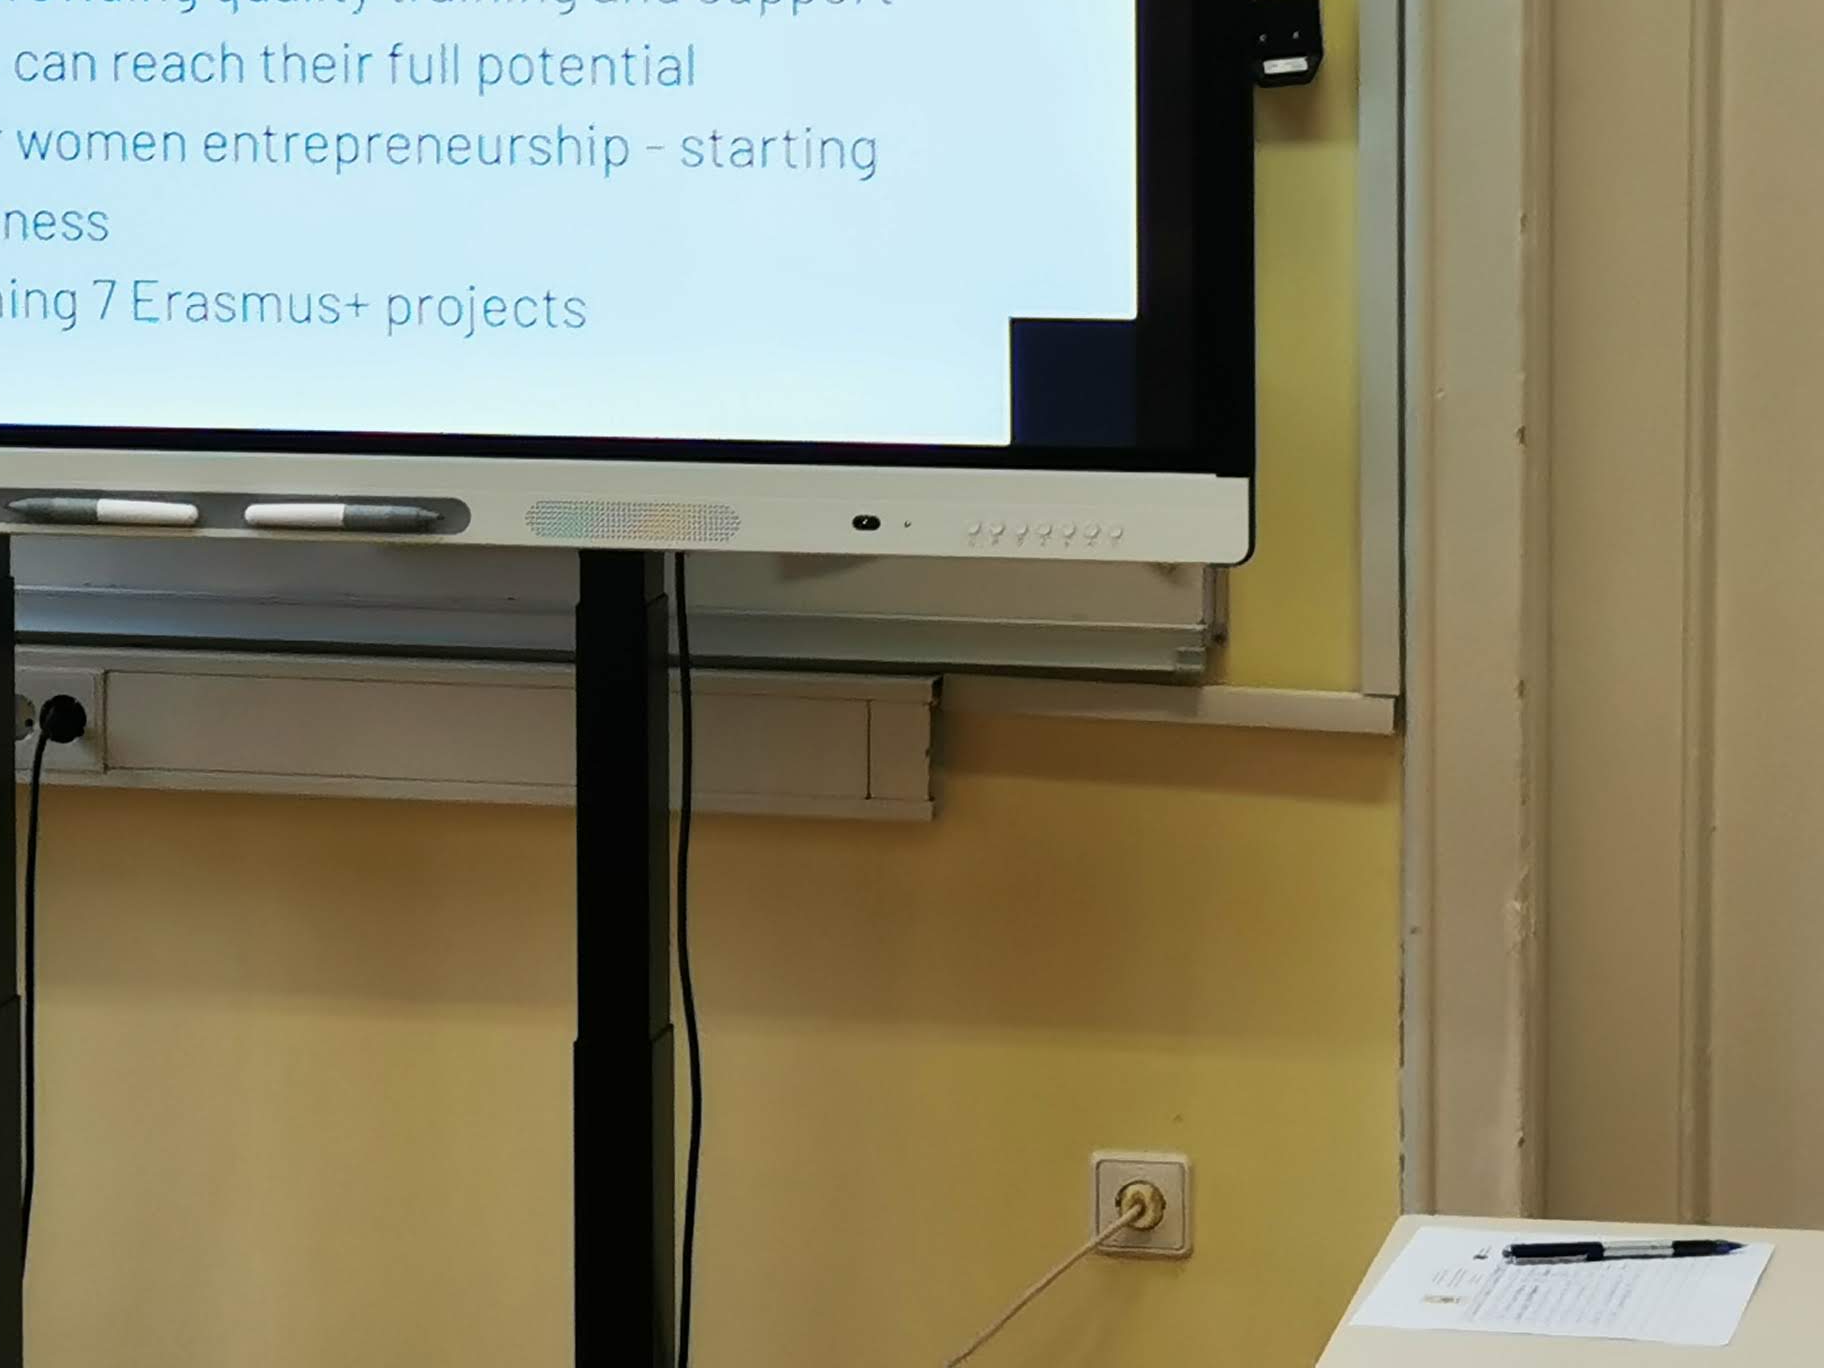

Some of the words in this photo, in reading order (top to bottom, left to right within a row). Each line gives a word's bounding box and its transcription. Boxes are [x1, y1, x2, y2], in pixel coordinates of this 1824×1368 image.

[15, 46, 96, 82] can
[113, 41, 245, 84] reach
[262, 42, 374, 85] their
[390, 42, 461, 86] full
[478, 43, 697, 96] potential
[17, 127, 186, 163] women
[203, 123, 630, 179] entrepreneurship
[680, 127, 879, 182] starting
[92, 278, 117, 321] 7
[133, 279, 369, 325] Erasmus+
[388, 285, 588, 339] projects
